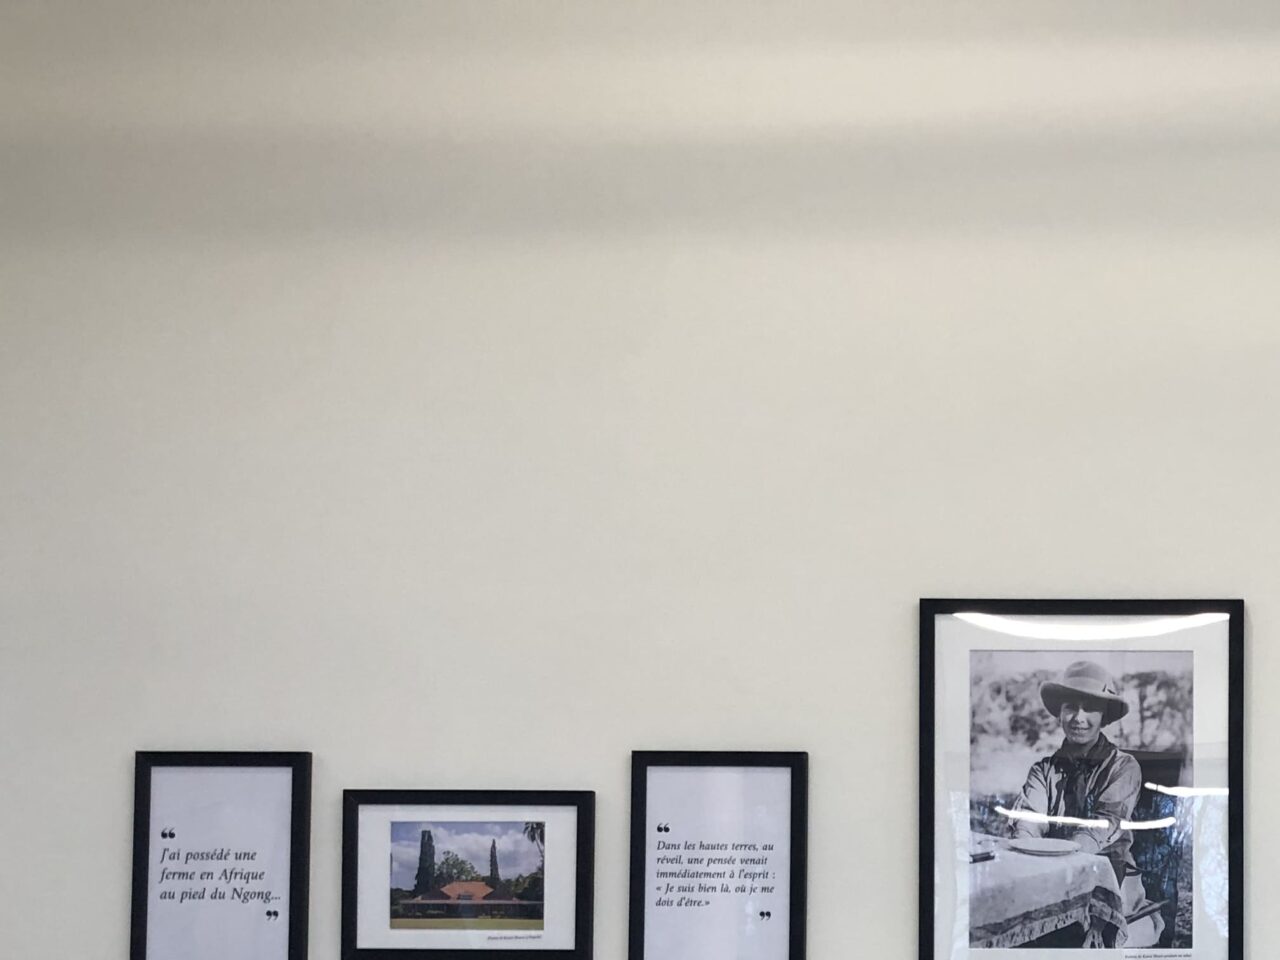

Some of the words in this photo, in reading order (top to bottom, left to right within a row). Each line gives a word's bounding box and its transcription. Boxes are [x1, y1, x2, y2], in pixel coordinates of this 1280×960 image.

[657, 840, 681, 851] Dans
[684, 840, 696, 851] les
[699, 840, 728, 851] hautes
[762, 843, 774, 851] au
[160, 848, 180, 865] J'ai
[185, 848, 230, 865] possédé
[235, 852, 257, 861] une
[707, 855, 736, 868] pensée
[740, 855, 768, 865] venait
[159, 867, 196, 884] ferme
[200, 871, 214, 881] en
[219, 867, 265, 884] Afrique
[656, 869, 725, 879] immédiatement
[729, 869, 735, 879] à
[738, 869, 769, 882] l'esprit
[160, 891, 175, 900] au
[180, 887, 206, 905] pied
[210, 887, 226, 900] du
[664, 883, 675, 896] Je
[677, 883, 695, 893] suis
[698, 883, 717, 893] bien
[735, 883, 746, 893] où
[749, 886, 758, 896] je
[655, 897, 674, 907] dois
[677, 897, 710, 907] d'être.»
